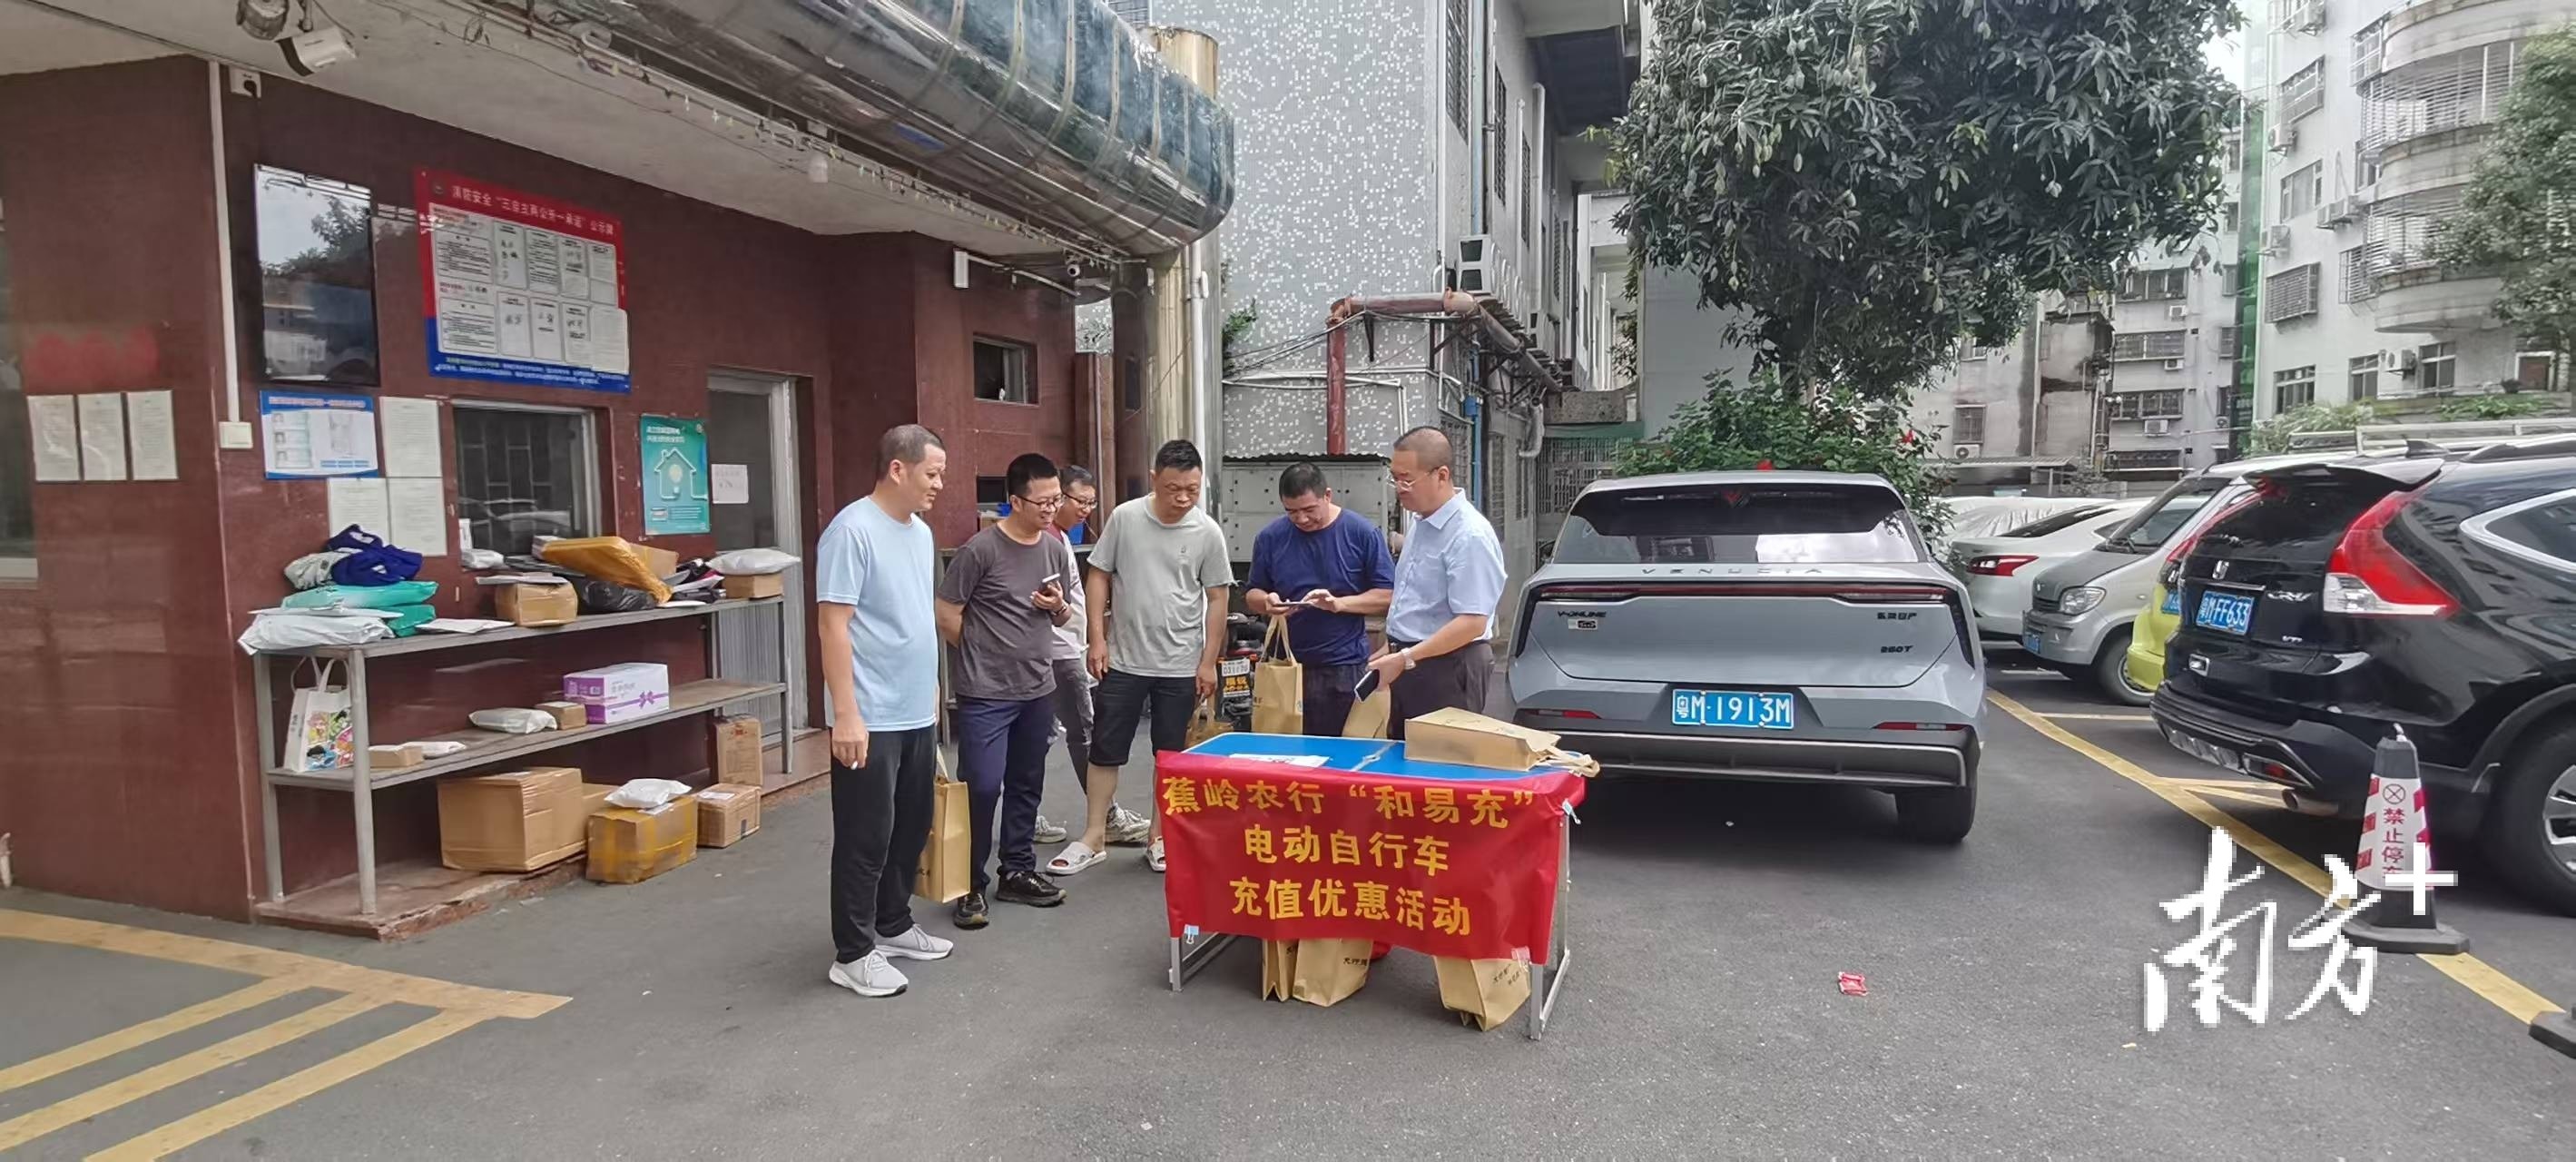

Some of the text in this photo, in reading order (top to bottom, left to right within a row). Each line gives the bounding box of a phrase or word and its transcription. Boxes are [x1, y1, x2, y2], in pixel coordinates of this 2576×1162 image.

[1244, 823, 1451, 877] 电动自行车
[1229, 876, 1471, 937] 充值优惠活动
